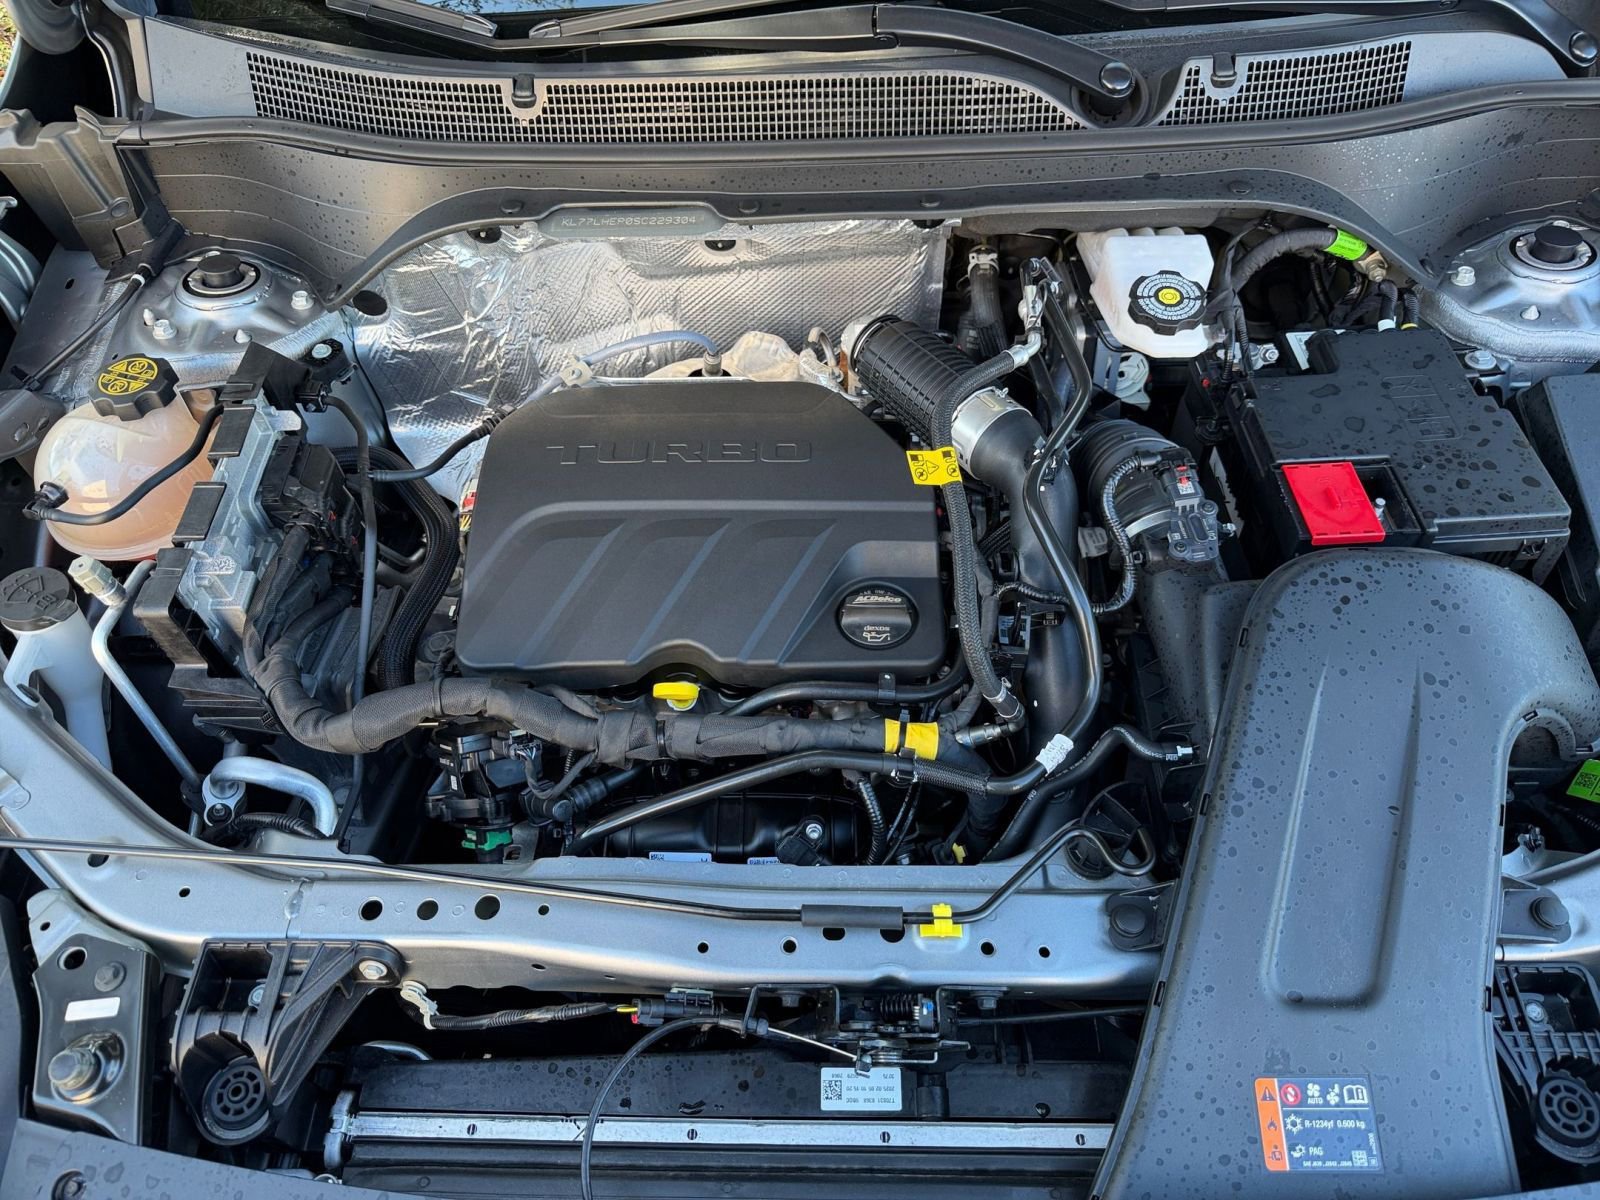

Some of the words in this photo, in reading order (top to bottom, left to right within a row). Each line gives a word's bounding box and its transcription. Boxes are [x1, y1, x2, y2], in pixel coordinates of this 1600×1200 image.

[561, 215, 697, 227] KL77LHEP0SC229304
[545, 440, 813, 466] TURBO
[852, 595, 902, 604] ACDelco
[1307, 1097, 1324, 1105] AUTO
[1304, 1119, 1334, 1130] R-1234yf
[1356, 1119, 1366, 1130] kg
[1308, 1146, 1324, 1155] PAG
